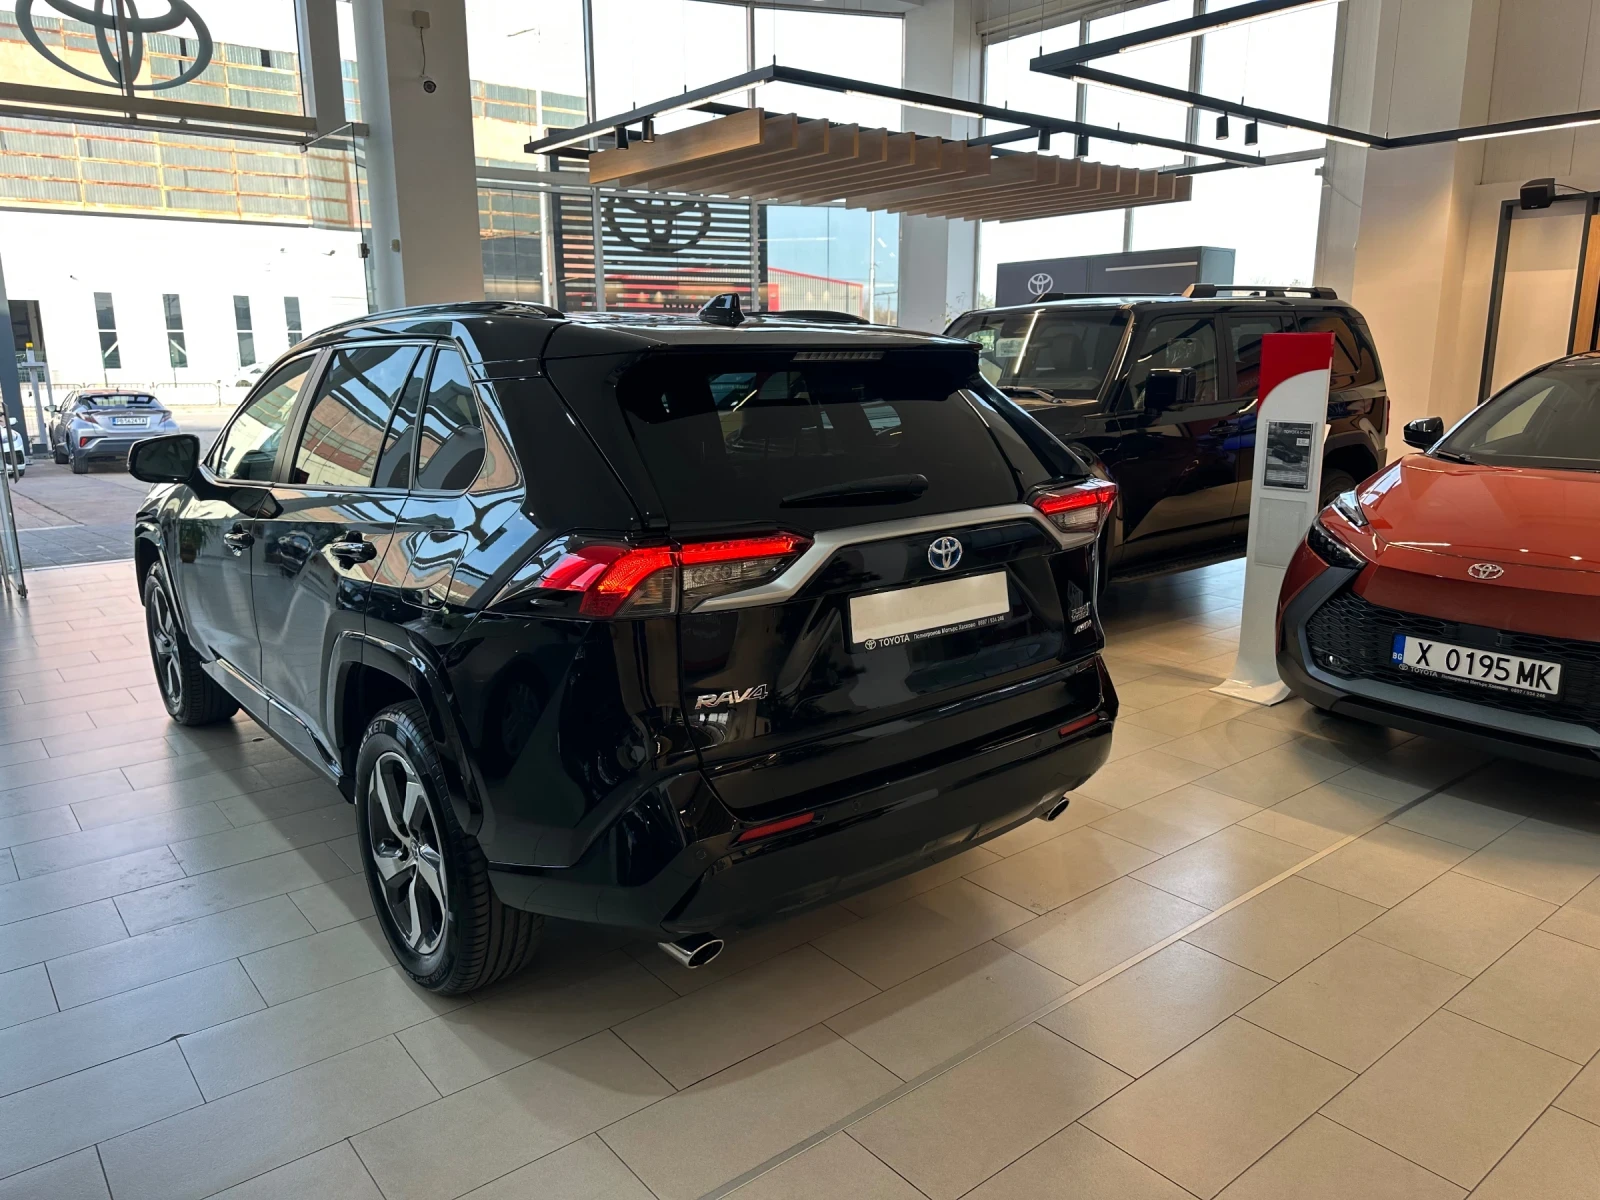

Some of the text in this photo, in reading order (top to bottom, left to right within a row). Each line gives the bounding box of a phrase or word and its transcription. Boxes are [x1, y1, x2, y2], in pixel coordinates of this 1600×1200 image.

[878, 635, 911, 647] TOYOTA
[1392, 652, 1403, 661] BG
[1415, 642, 1433, 667] X
[1409, 665, 1439, 678] TOYOTA
[694, 683, 768, 710] RAV4
